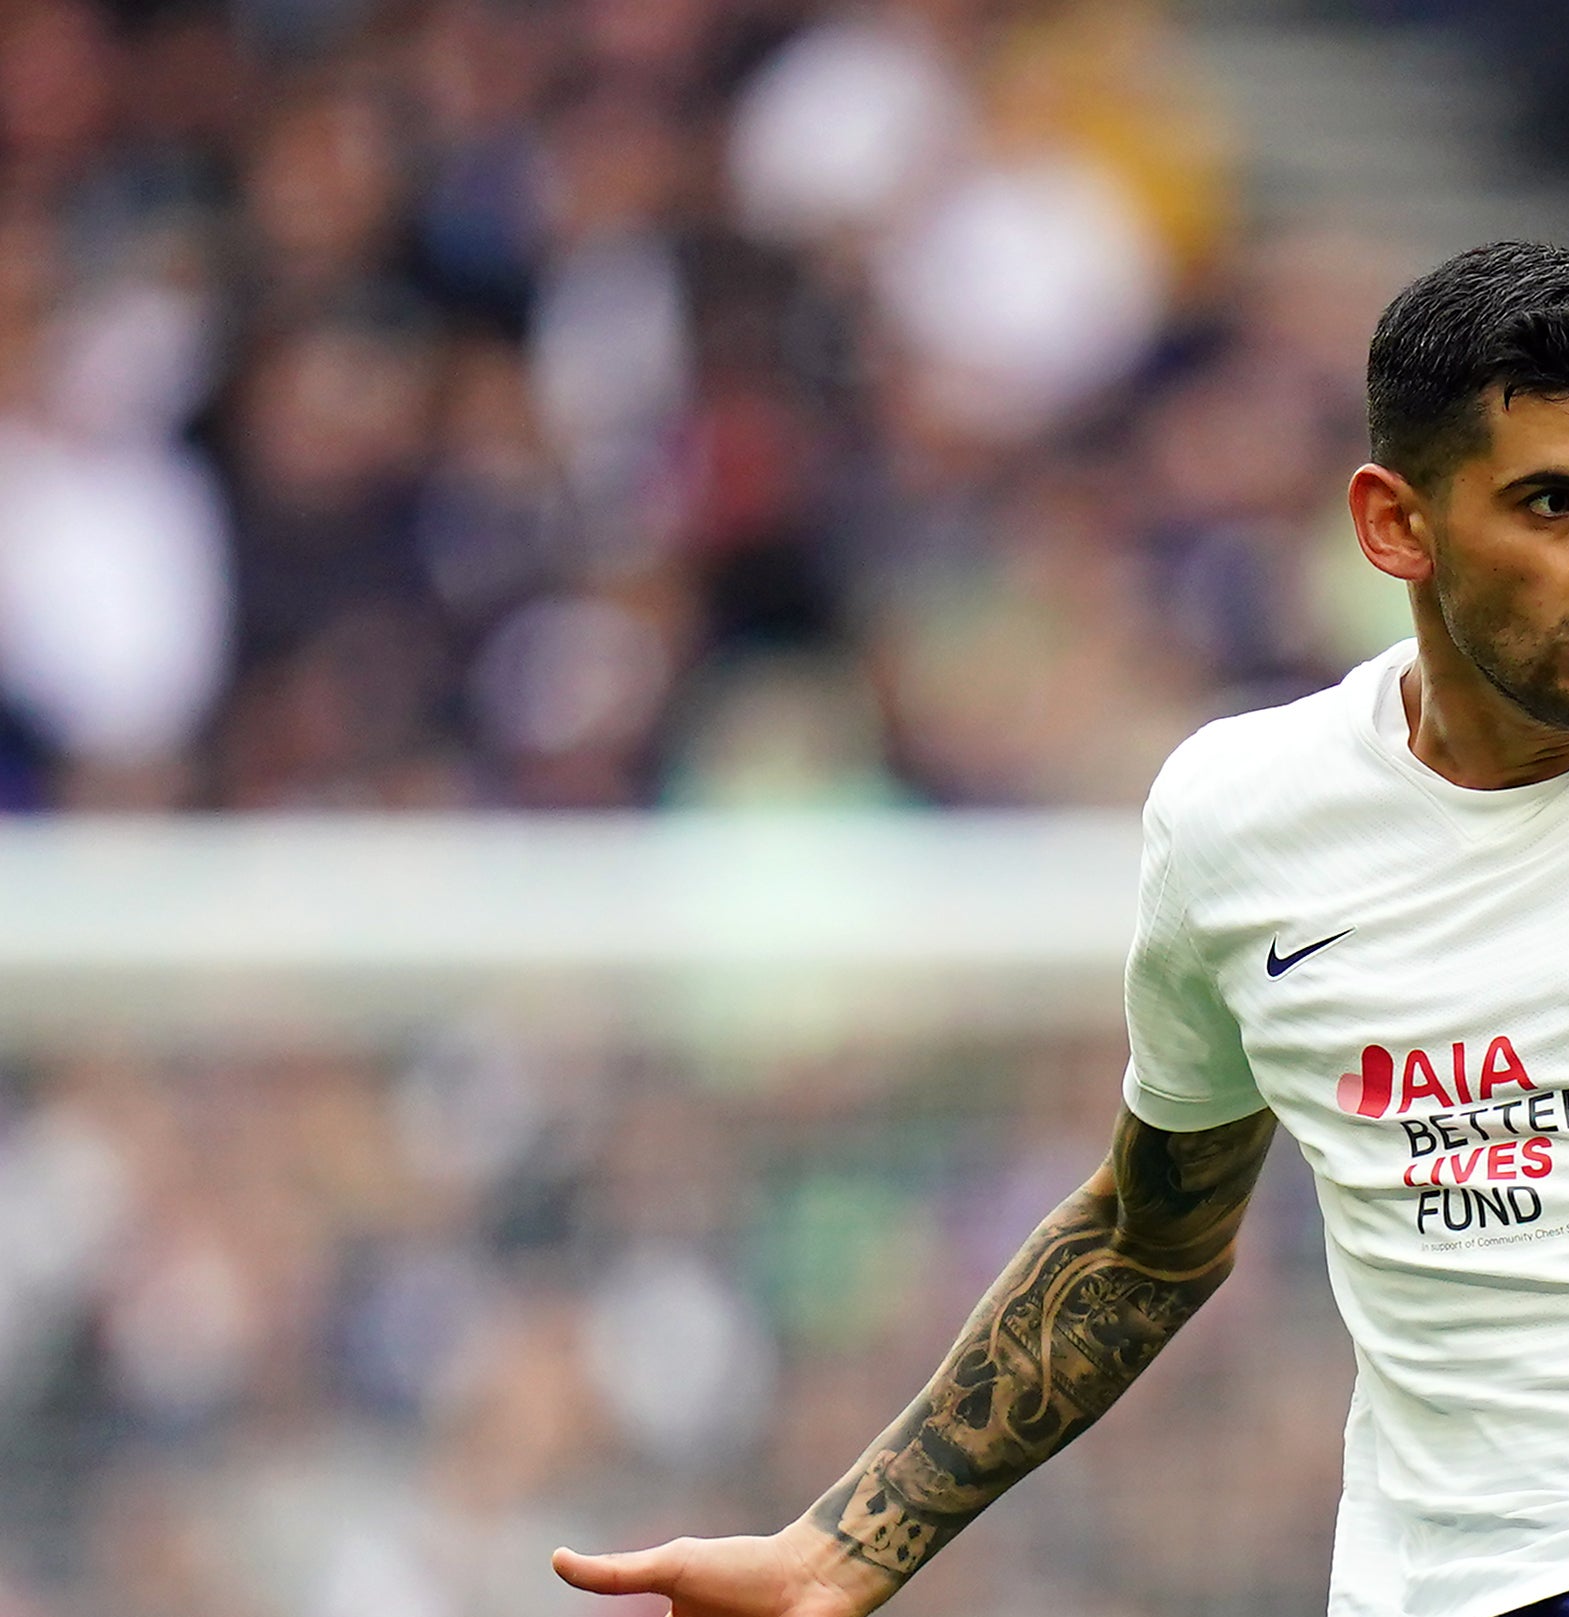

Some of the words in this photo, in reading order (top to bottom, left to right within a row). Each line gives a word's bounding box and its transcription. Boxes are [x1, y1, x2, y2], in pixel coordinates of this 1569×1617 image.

[1396, 1035, 1539, 1114] AIA
[1403, 1136, 1553, 1188] LIVES
[1417, 1185, 1543, 1235] FUND
[1477, 1232, 1534, 1248] Community
[1535, 1226, 1565, 1240] Chest
